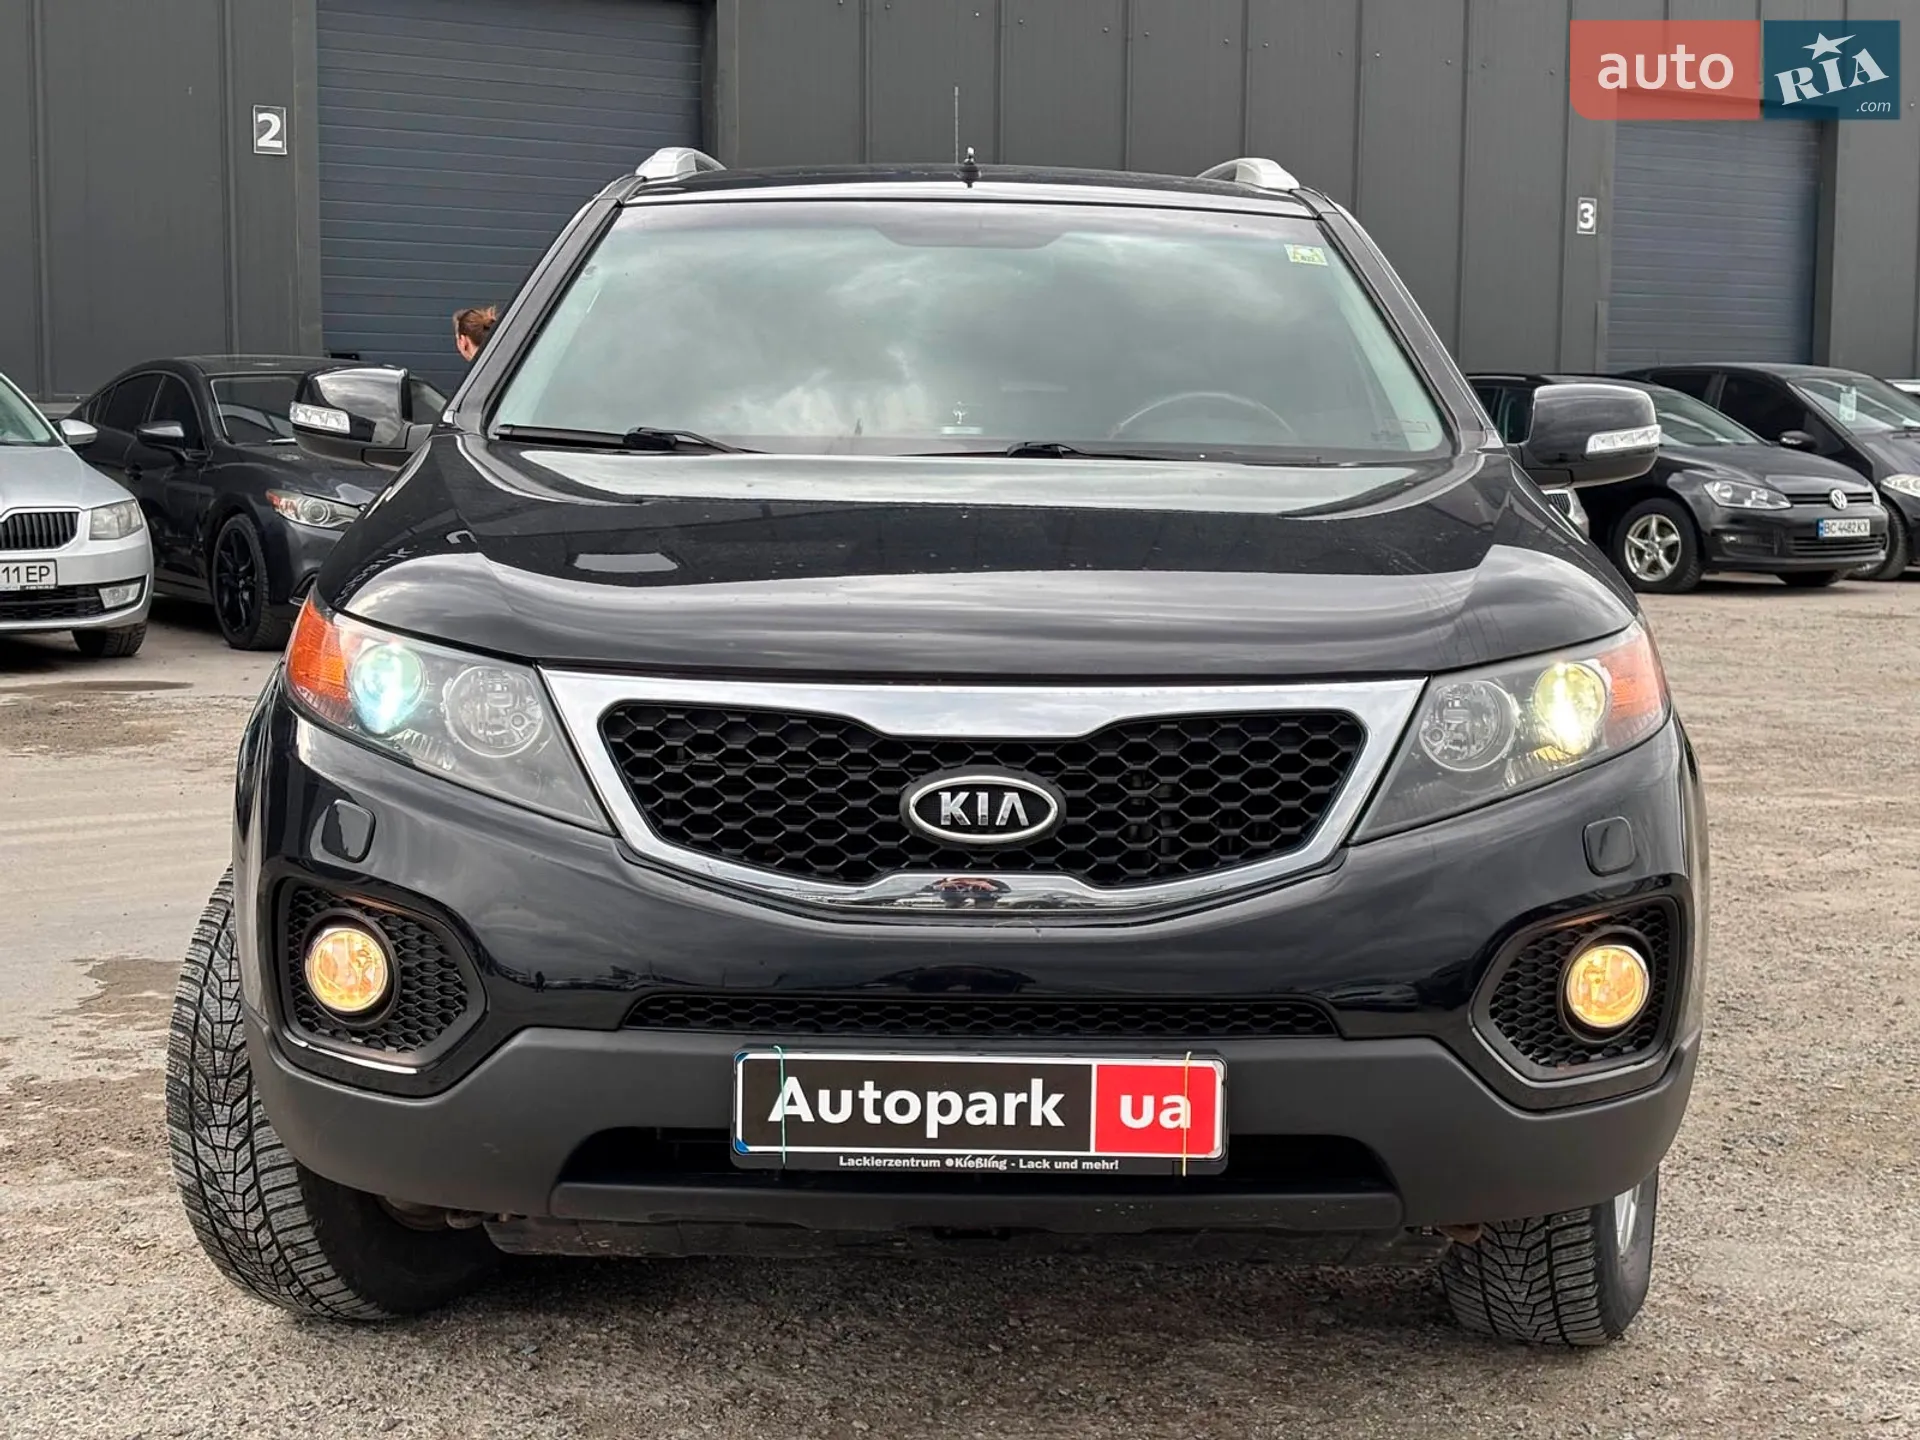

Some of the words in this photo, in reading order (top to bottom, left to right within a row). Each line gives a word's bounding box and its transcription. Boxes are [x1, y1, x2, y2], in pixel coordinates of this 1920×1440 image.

[257, 112, 283, 148] 2
[1580, 202, 1594, 229] 3
[26, 565, 50, 583] EP
[938, 791, 1030, 826] KIA
[767, 1076, 1066, 1139] Autopark
[1118, 1092, 1192, 1130] ua
[838, 1155, 941, 1168] Lackierzentrum
[1018, 1158, 1051, 1169] Lack
[1053, 1158, 1079, 1170] und
[1081, 1159, 1120, 1171] mehr!
